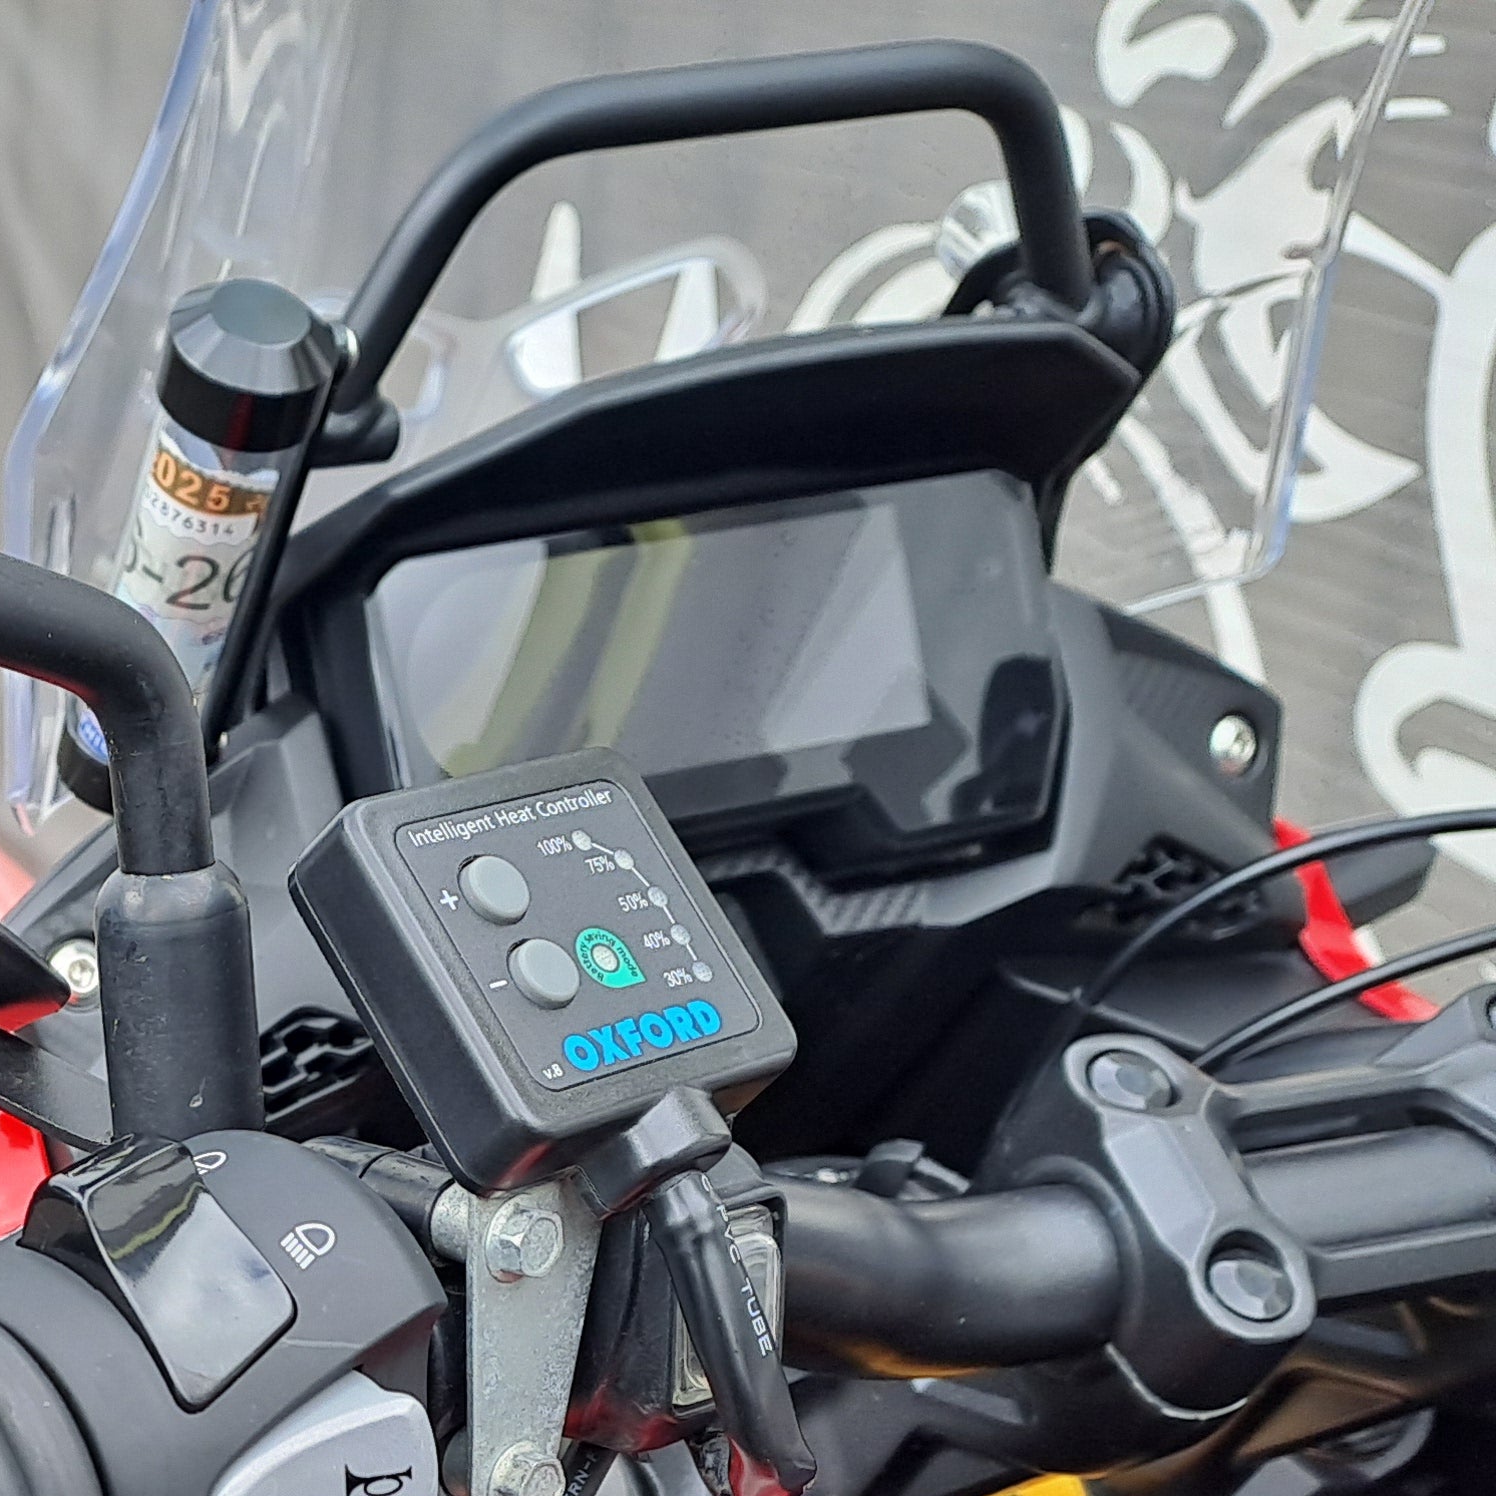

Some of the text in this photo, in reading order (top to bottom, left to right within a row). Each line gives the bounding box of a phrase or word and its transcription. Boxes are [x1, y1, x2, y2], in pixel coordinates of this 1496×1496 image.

[408, 789, 613, 847] Intelligent Heat Controller
[537, 836, 573, 855] 100%
[585, 856, 616, 874] 75%
[618, 892, 649, 912] 50%
[643, 930, 671, 949] 40%
[617, 946, 639, 978] mode
[663, 968, 693, 987] 30%
[563, 999, 721, 1072] OXFORD
[542, 1063, 564, 1080] v.8
[740, 1276, 774, 1358] TUBE
